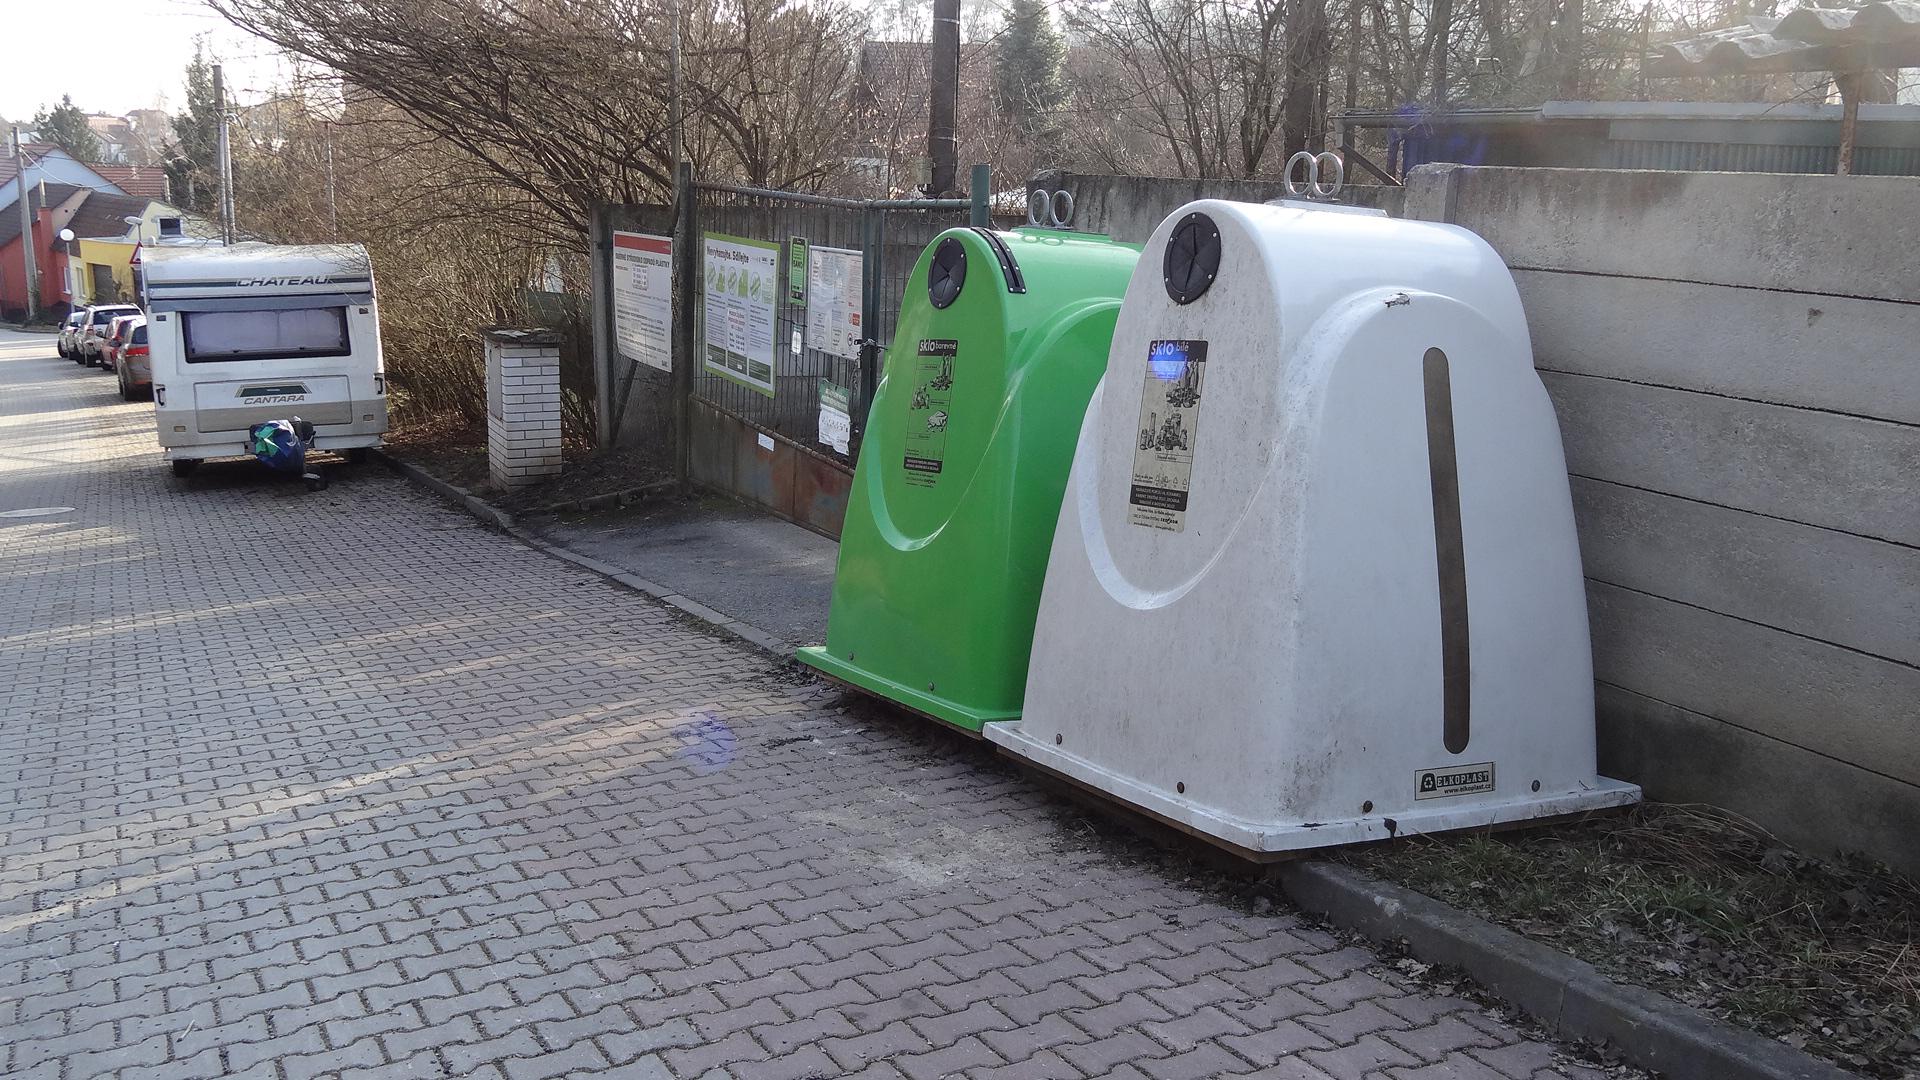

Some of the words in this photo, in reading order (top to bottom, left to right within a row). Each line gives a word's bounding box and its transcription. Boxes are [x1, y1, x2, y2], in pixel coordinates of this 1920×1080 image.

[237, 276, 329, 287] CHATEAU
[920, 339, 935, 352] sklo
[1150, 340, 1174, 356] sklo
[244, 394, 305, 405] CANTARA
[1437, 772, 1489, 787] ELKOPLAST
